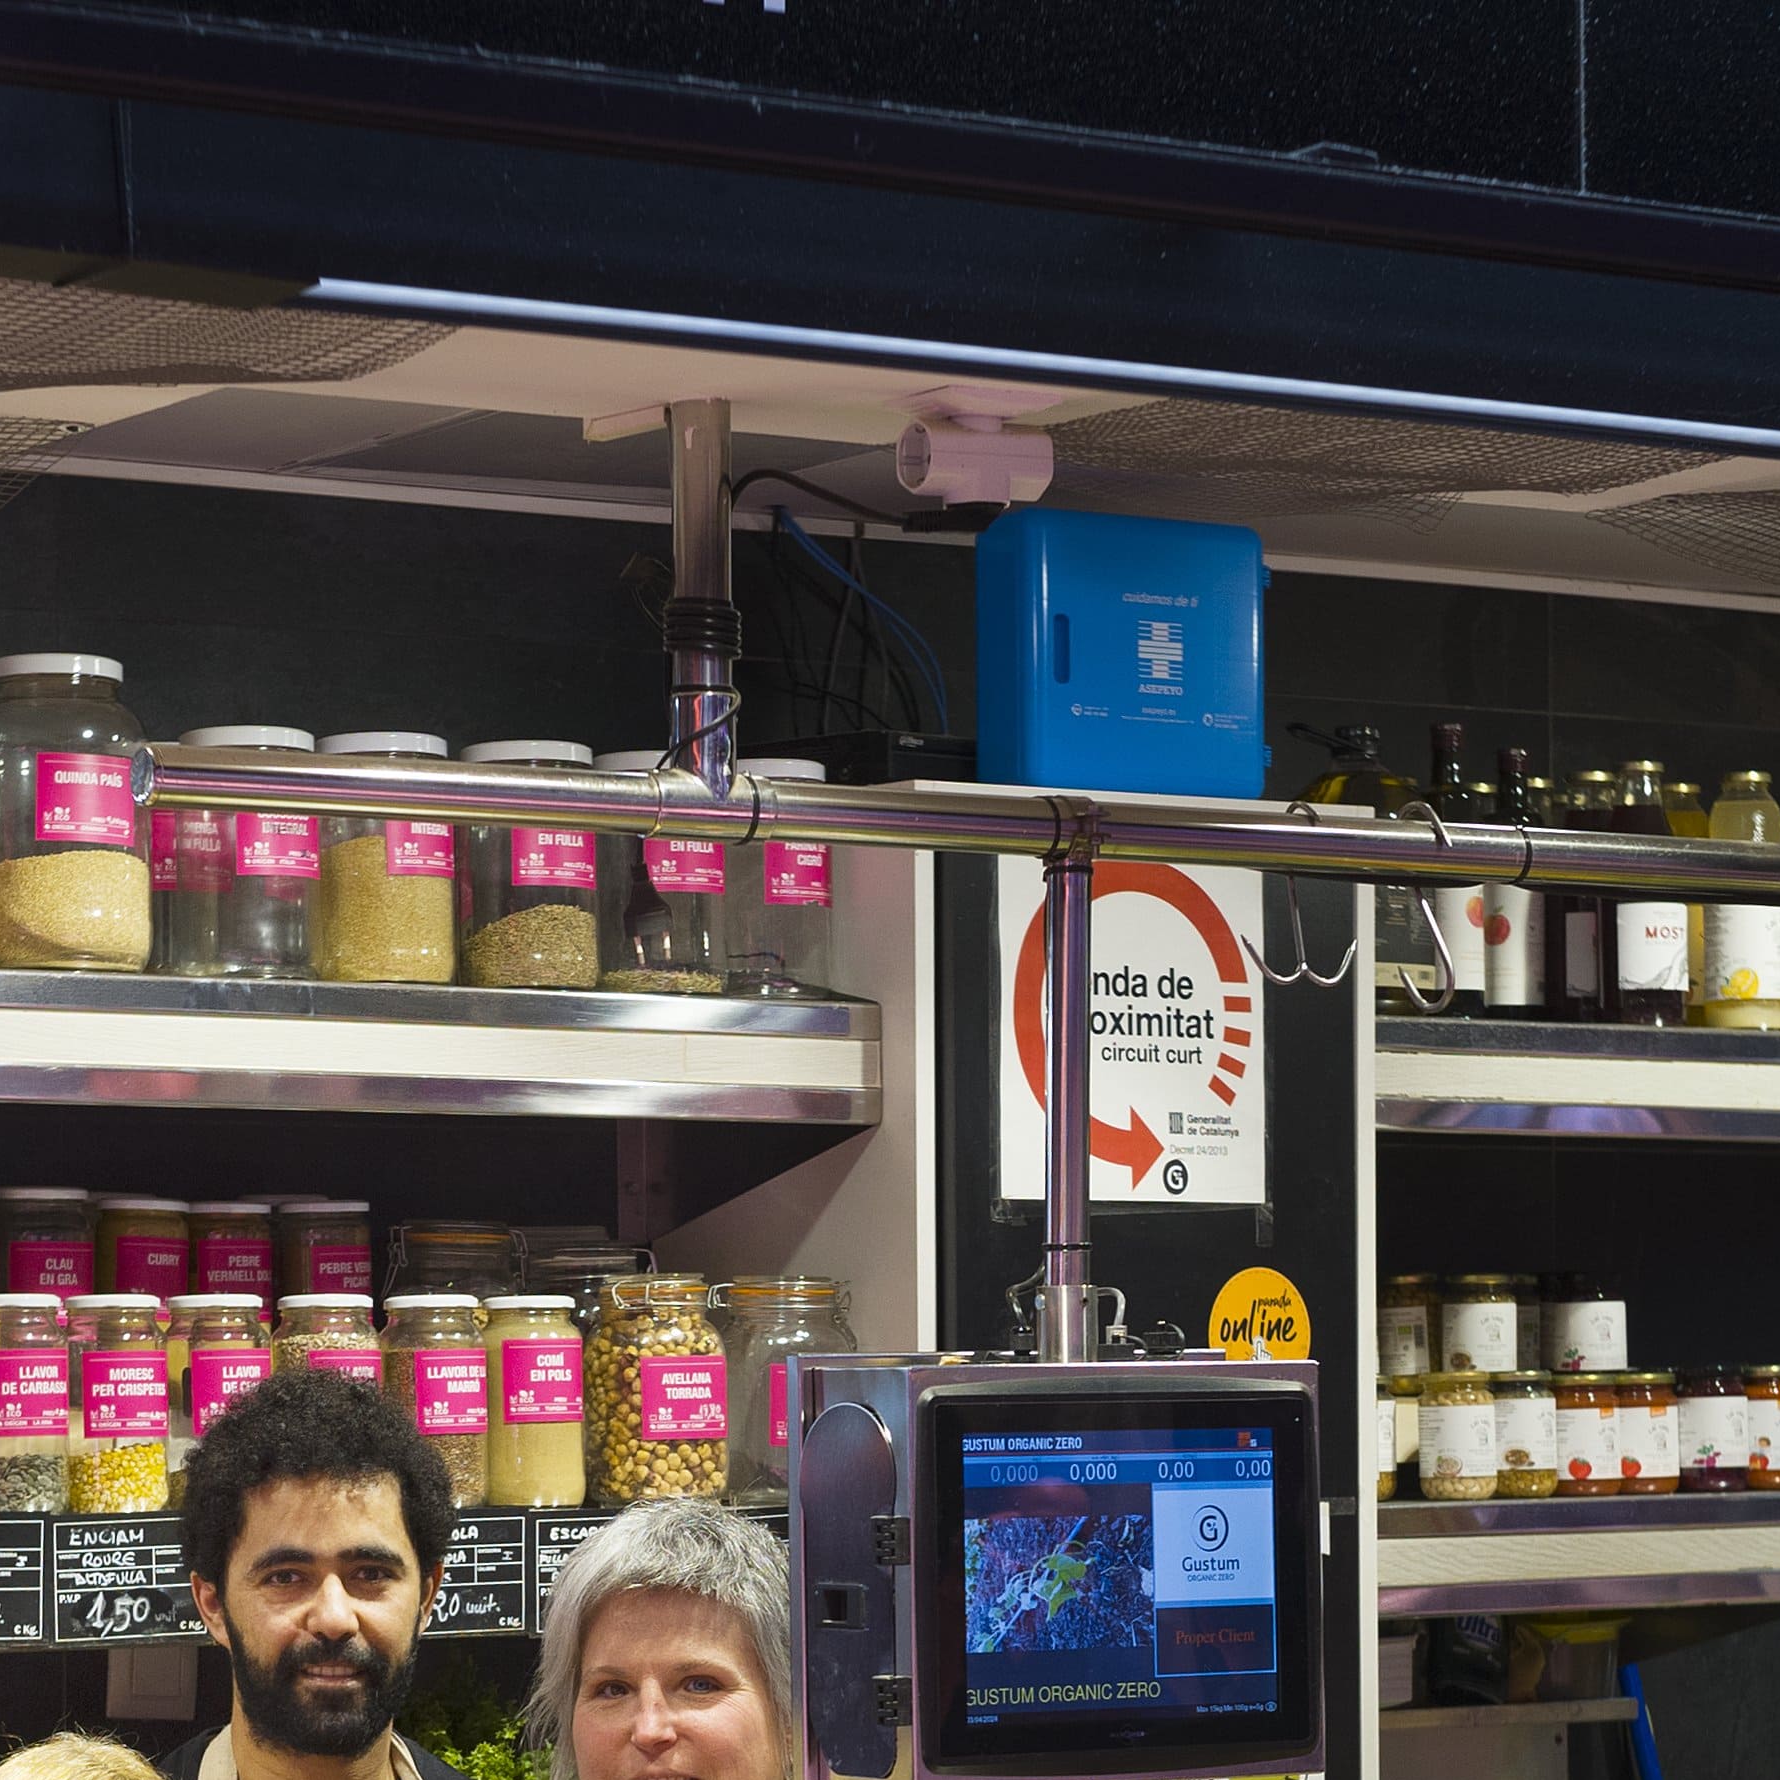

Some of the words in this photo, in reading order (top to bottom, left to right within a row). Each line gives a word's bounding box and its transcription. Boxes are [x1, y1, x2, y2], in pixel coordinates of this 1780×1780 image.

[54, 770, 97, 786] QUINOA
[100, 773, 123, 788] PAÍS
[262, 822, 309, 837] INTEGRAL
[411, 823, 450, 837] INTEGRAL
[538, 833, 553, 846] EN
[554, 834, 584, 848] FULLA
[670, 841, 685, 852] EN
[686, 841, 715, 854] FULLA
[1091, 966, 1147, 998] nda
[1157, 967, 1194, 1000] de
[1090, 1005, 1214, 1039] oximitat
[1101, 1042, 1160, 1063] circuit
[1166, 1045, 1203, 1065] curt
[1187, 1114, 1231, 1125] Generalitat
[1199, 1126, 1240, 1139] Catalunya
[45, 1258, 73, 1270] CLAU
[148, 1253, 180, 1265] CURRY
[229, 1255, 261, 1267] PEBRE
[319, 1262, 353, 1274] PEBRE
[39, 1273, 54, 1285] EN
[55, 1273, 78, 1286] GRA
[207, 1270, 256, 1282] VERMELL
[1220, 1299, 1297, 1345] online
[19, 1366, 58, 1379] LLAVOR
[109, 1368, 154, 1381] MORESC
[222, 1365, 261, 1379] LLAVOR
[427, 1365, 467, 1379] LLAVOR
[530, 1368, 544, 1381] EN
[546, 1368, 572, 1381] POLS
[662, 1372, 711, 1385] AVELLANA
[1, 1382, 17, 1395] DE
[92, 1384, 114, 1397] PER
[117, 1383, 166, 1397] CRISPETES
[222, 1381, 237, 1394] DE
[666, 1387, 712, 1400] TORRADA
[962, 1438, 1005, 1452] GUSTUM
[1008, 1437, 1053, 1451] ORGANIC
[1055, 1437, 1082, 1449] ZERO
[990, 1465, 1038, 1483] 0,000
[1069, 1463, 1117, 1481] 0,000
[1158, 1461, 1194, 1479] 0,00
[1235, 1459, 1271, 1478] 0,00
[69, 1528, 144, 1545] ENCIAM
[82, 1551, 136, 1568] ROURE
[1182, 1555, 1240, 1572] Gustum
[1187, 1574, 1214, 1582] ORGANIC
[1215, 1573, 1235, 1582] ZERO
[85, 1591, 150, 1637] 1,50
[1176, 1629, 1214, 1645] Proper
[1218, 1628, 1255, 1643] Client
[966, 1687, 1034, 1706] GUSTUM
[1038, 1683, 1112, 1703] ORGANIC
[1117, 1681, 1161, 1699] ZERO
